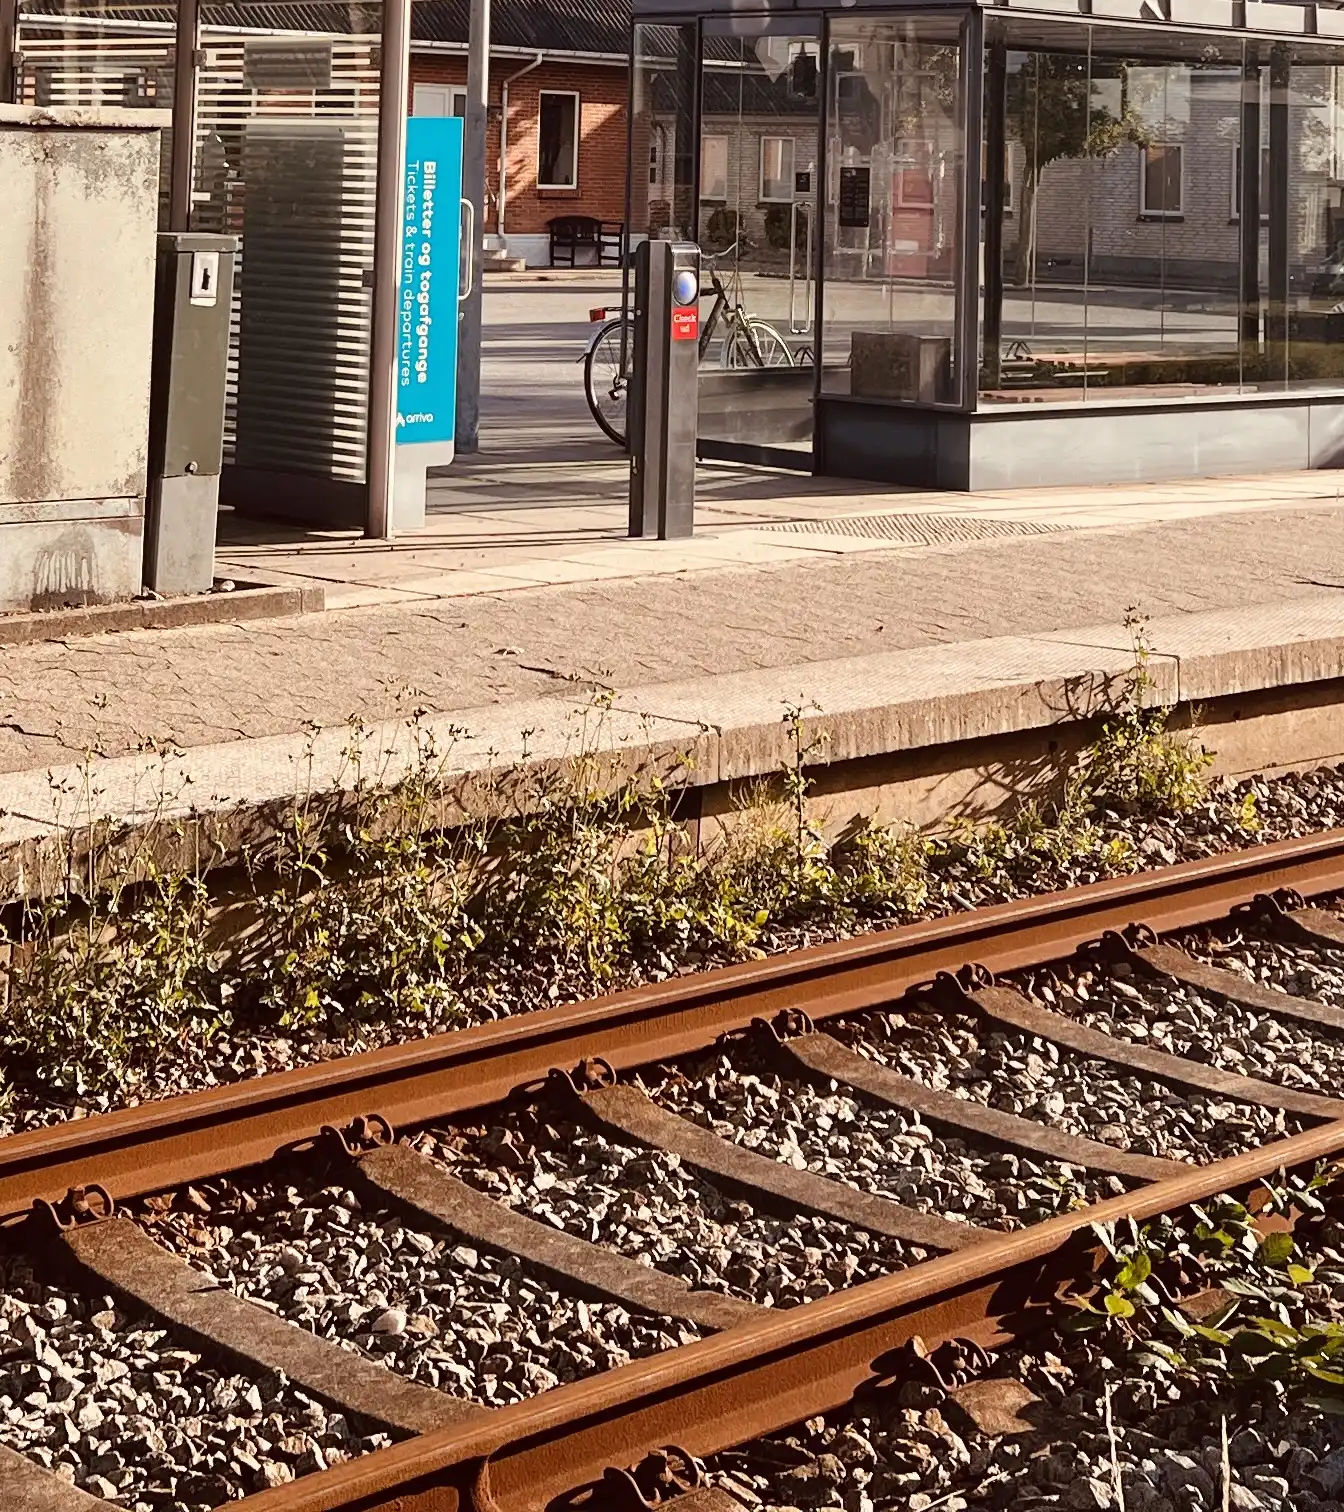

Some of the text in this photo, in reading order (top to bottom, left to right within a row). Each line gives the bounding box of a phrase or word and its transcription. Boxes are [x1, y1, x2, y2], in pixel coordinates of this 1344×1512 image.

[400, 160, 419, 386] Tickets & train departures
[415, 161, 436, 383] Billetter og togafgange
